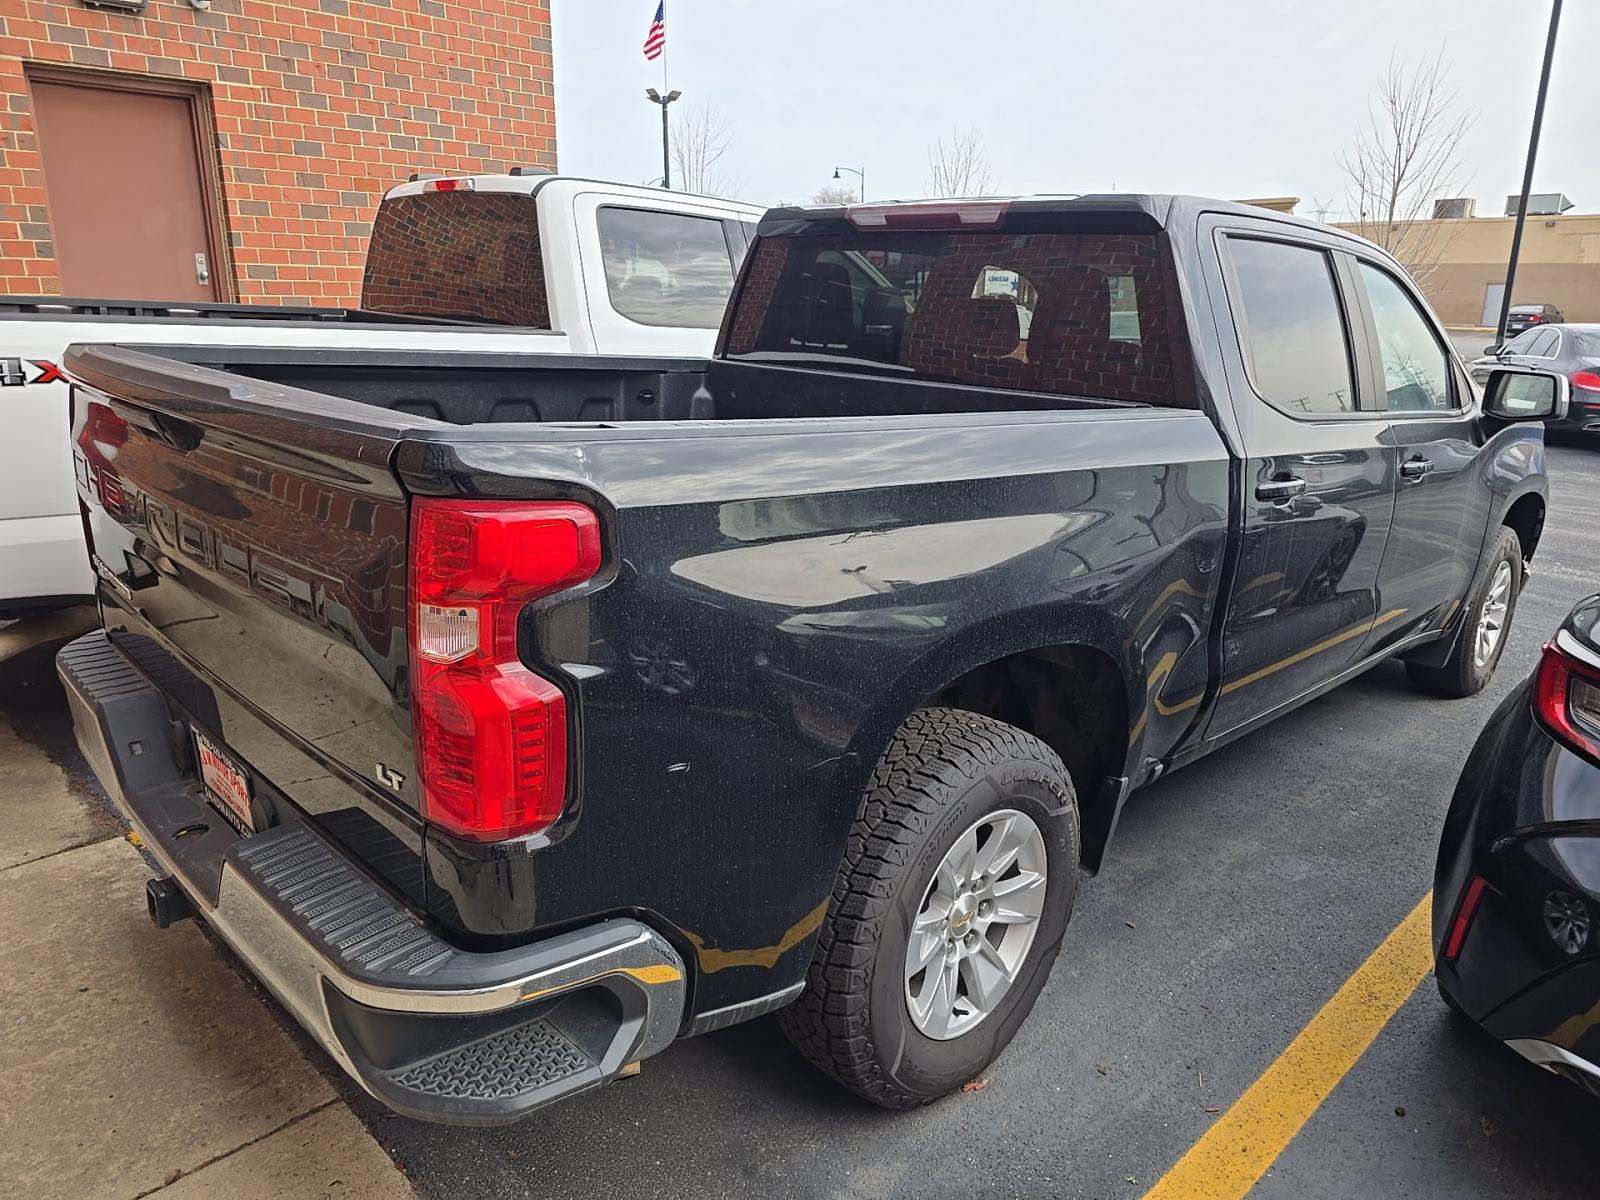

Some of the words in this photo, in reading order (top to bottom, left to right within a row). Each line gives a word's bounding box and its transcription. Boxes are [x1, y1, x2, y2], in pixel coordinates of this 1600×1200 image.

[71, 446, 346, 626] CHEVROLET
[375, 762, 404, 790] LT
[1001, 766, 1067, 805] COOPER
